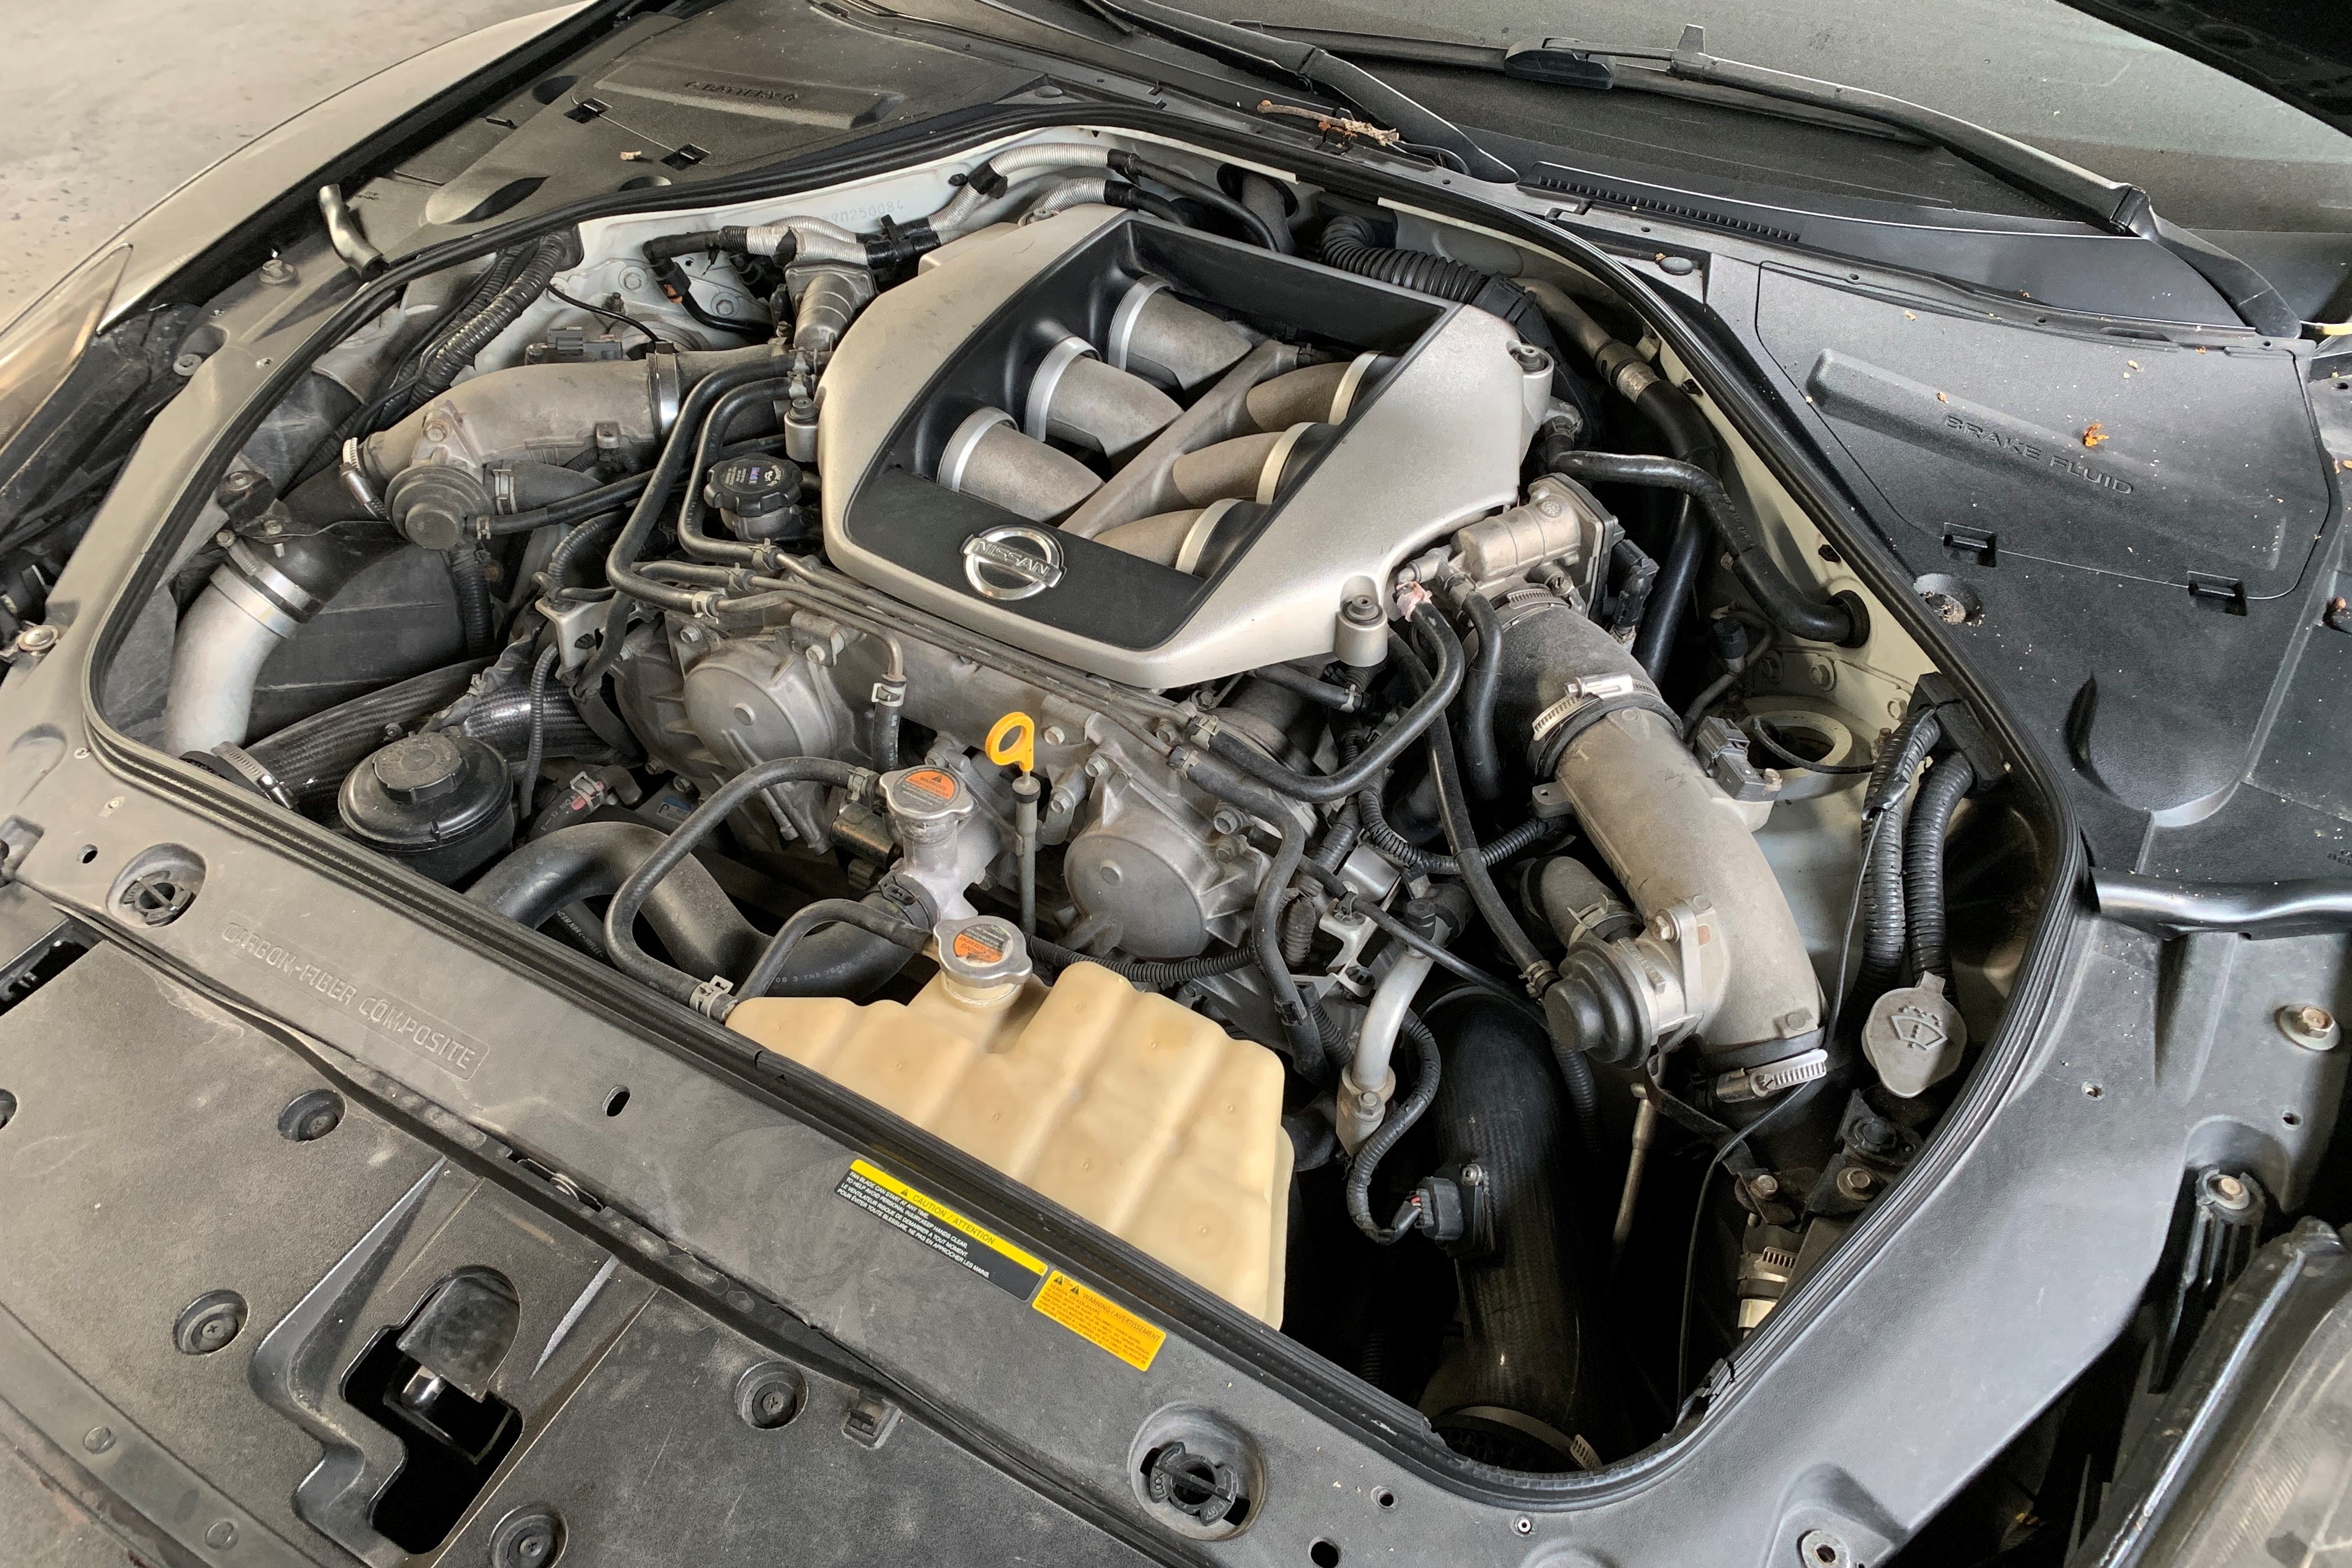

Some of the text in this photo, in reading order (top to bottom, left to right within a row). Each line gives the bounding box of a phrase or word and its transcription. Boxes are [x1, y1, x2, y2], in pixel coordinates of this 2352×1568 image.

[1945, 415, 2134, 495] BRAKE FLUID
[975, 541, 1051, 578] NISSAN
[961, 943, 991, 960] WNING
[221, 922, 476, 1070] CARBON-FIBER COMPOSITE
[846, 1186, 878, 1207] VENTILATEUR
[894, 1212, 903, 1221] DE
[932, 1234, 946, 1245] TOUT
[849, 1171, 860, 1180] FAN
[859, 1176, 875, 1189] BLADE
[874, 1185, 886, 1195] CAN
[884, 1191, 901, 1203] START
[905, 1203, 918, 1212] ANY
[852, 1180, 866, 1191] HELP
[864, 1187, 880, 1199] AVOID
[879, 1195, 905, 1213] PERSONAL
[932, 1225, 951, 1239] HANDS
[836, 1187, 852, 1199] POUR
[866, 1204, 883, 1217] TOUTE
[914, 1231, 926, 1241] PAS
[925, 1238, 934, 1246] EN
[932, 1241, 964, 1263] APPROCHER
[962, 1259, 974, 1268] LES
[911, 1193, 947, 1218] CAUTION
[952, 1217, 996, 1245] ATTENTION
[1049, 1283, 1101, 1315] XENON HEADLAMPS
[1081, 1292, 1111, 1313] WARNING
[1113, 1311, 1161, 1341] AVERTISSEMENT
[1154, 1472, 1165, 1498] LOCK
